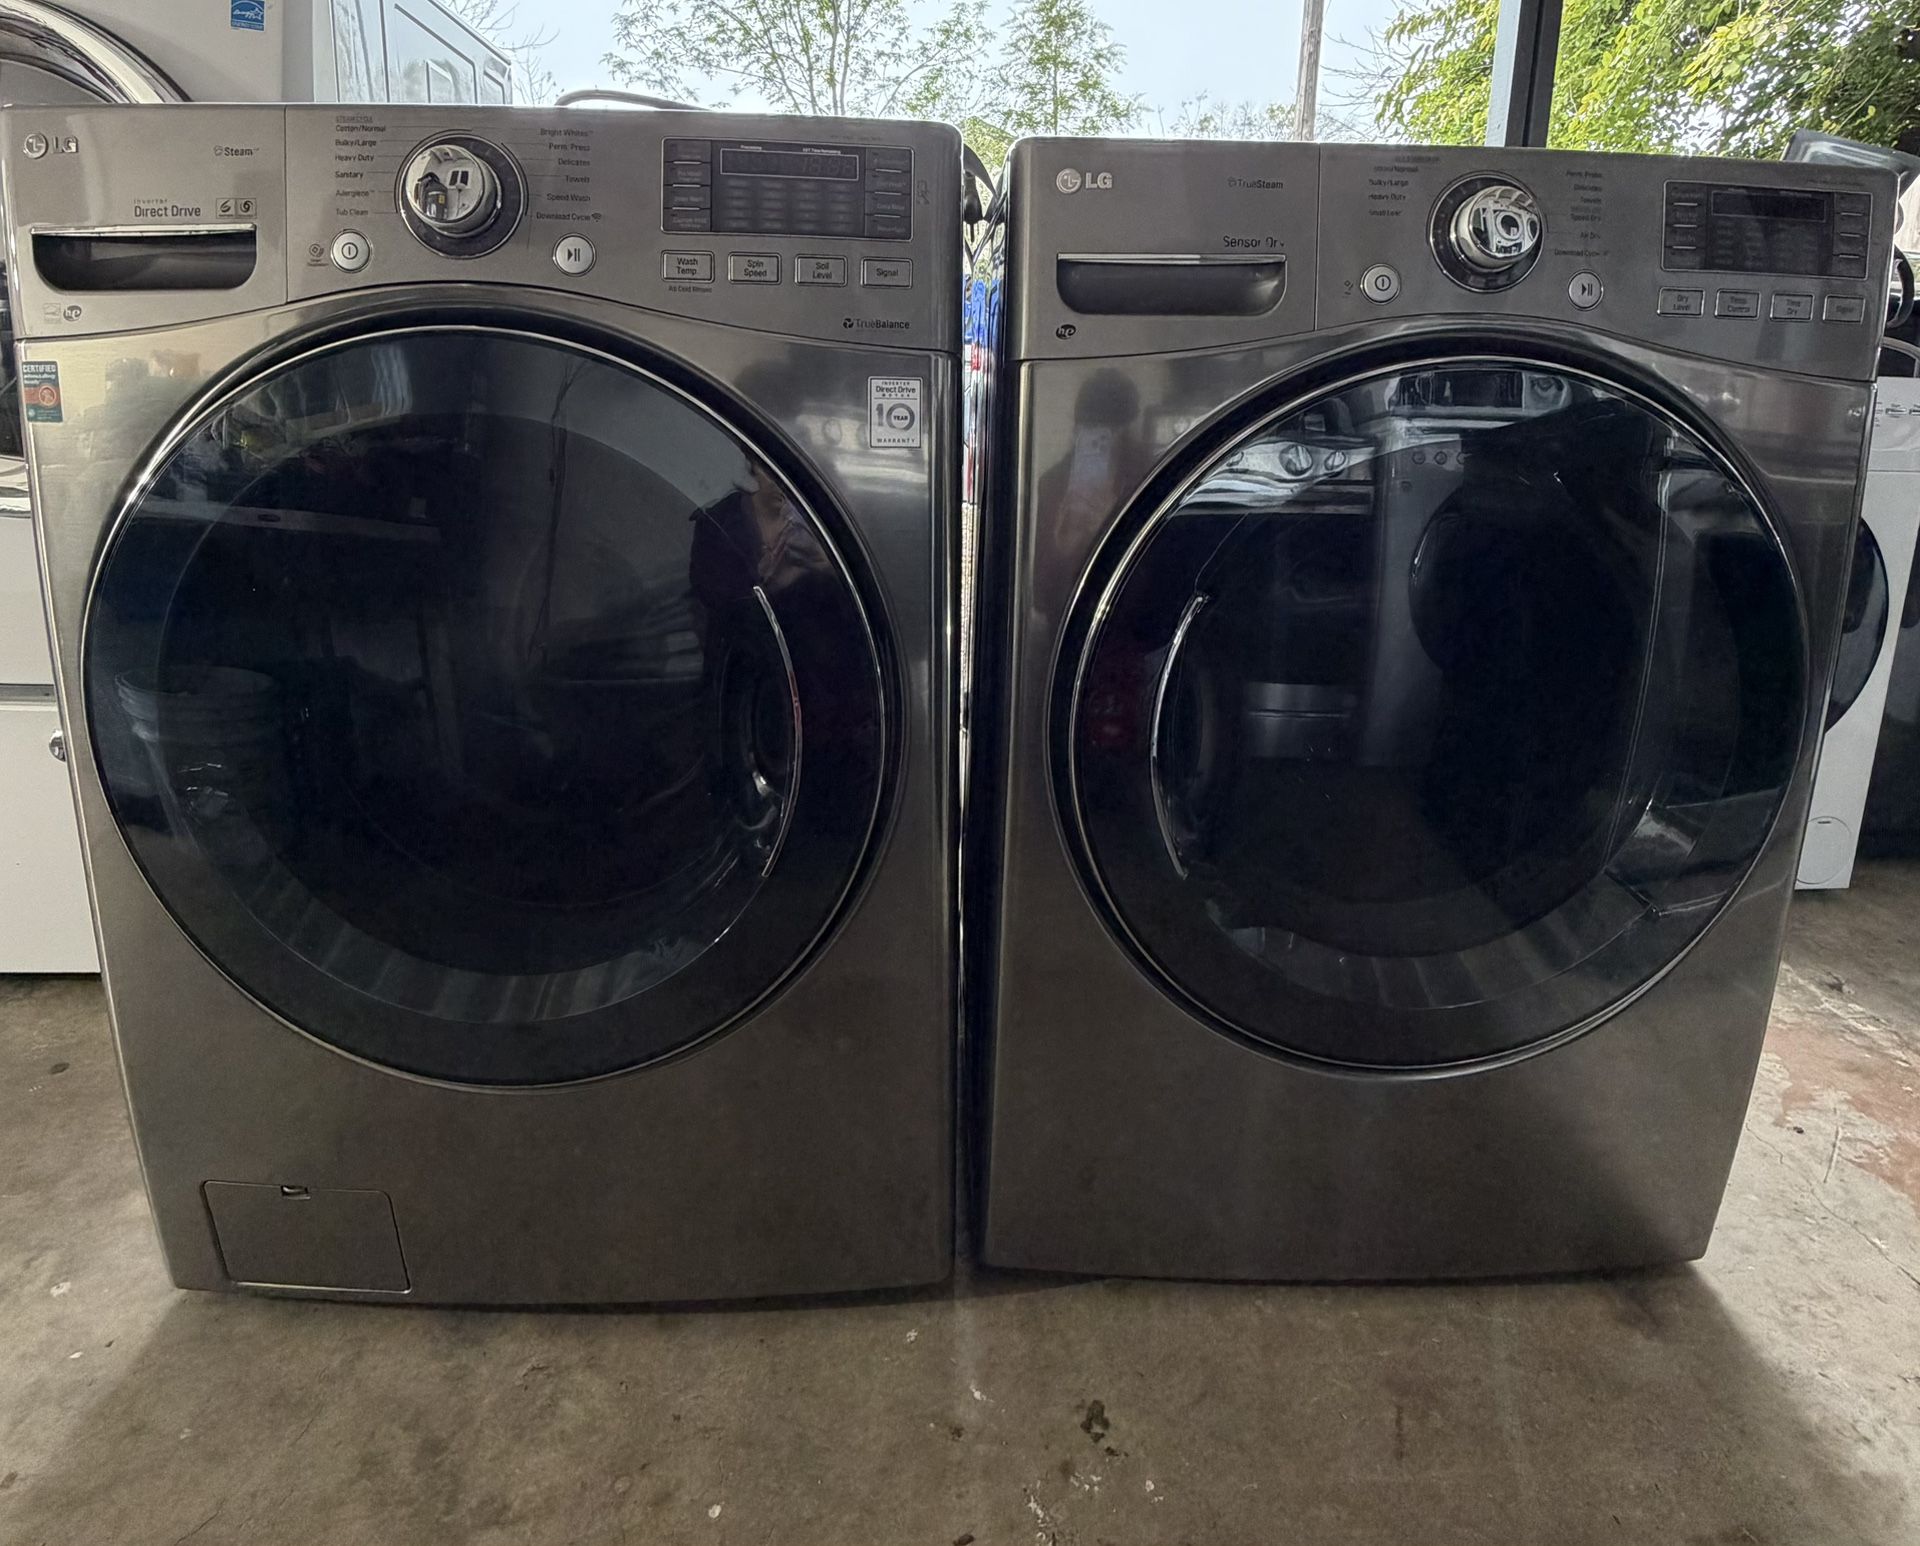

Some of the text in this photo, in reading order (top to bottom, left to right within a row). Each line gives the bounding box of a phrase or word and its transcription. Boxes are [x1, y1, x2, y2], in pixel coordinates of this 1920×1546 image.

[335, 124, 386, 132] Cotton/Normal
[51, 136, 79, 154] LG
[334, 138, 377, 147] Bulky/Large
[335, 155, 374, 163] Heavy Duty
[334, 170, 364, 180] Sanitary
[1085, 171, 1113, 189] LG
[1237, 178, 1284, 189] TrueSteam
[134, 205, 202, 218] Direct Drive
[1222, 235, 1261, 248] Sensor
[676, 257, 699, 267] Wash
[746, 258, 765, 270] Spin
[814, 261, 830, 271] Soil
[675, 266, 697, 277] Temp
[743, 267, 768, 280] Speed
[811, 270, 833, 281] Level
[876, 267, 899, 279] Signal
[856, 318, 910, 330] TrueBalance
[23, 364, 57, 373] CERTIFIED
[875, 385, 916, 394] Direct Drive
[875, 402, 916, 431] 10
